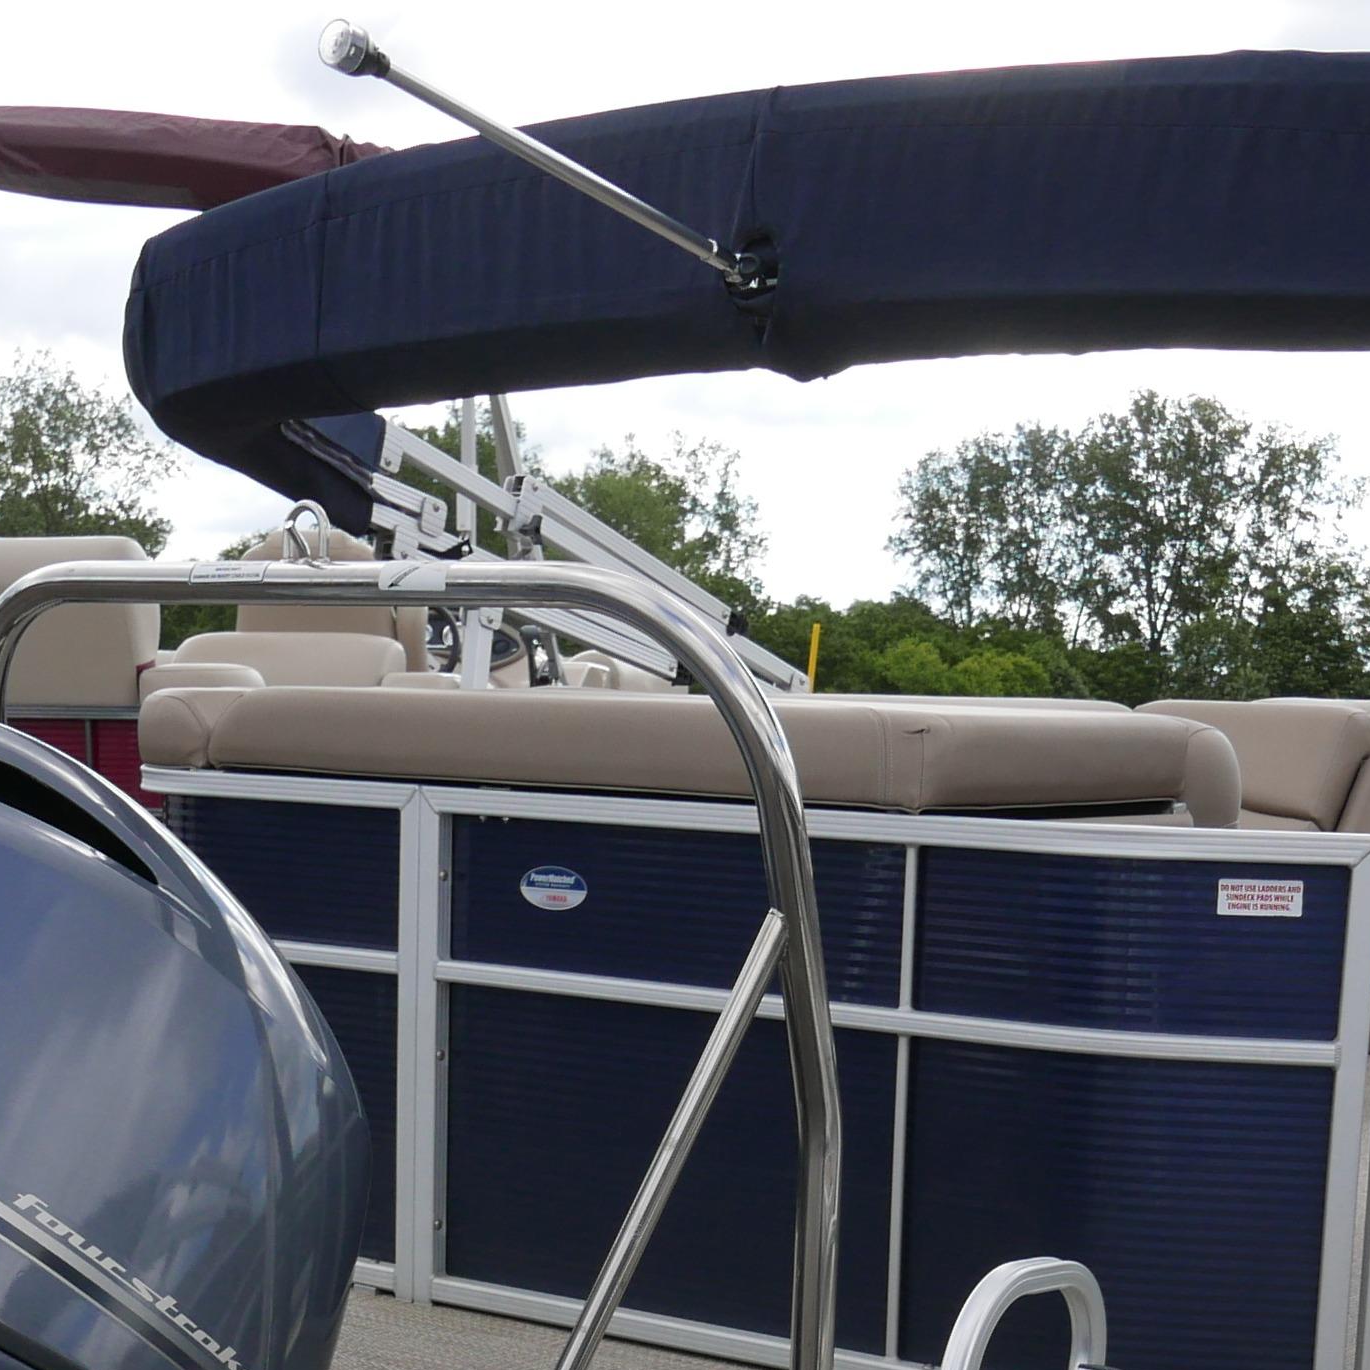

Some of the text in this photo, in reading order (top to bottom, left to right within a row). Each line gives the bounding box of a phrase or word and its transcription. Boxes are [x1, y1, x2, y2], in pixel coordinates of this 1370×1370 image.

[1230, 884, 1243, 892] NOT
[1244, 884, 1256, 892] USE
[1288, 885, 1301, 893] AND
[1227, 902, 1251, 910] ENGINE
